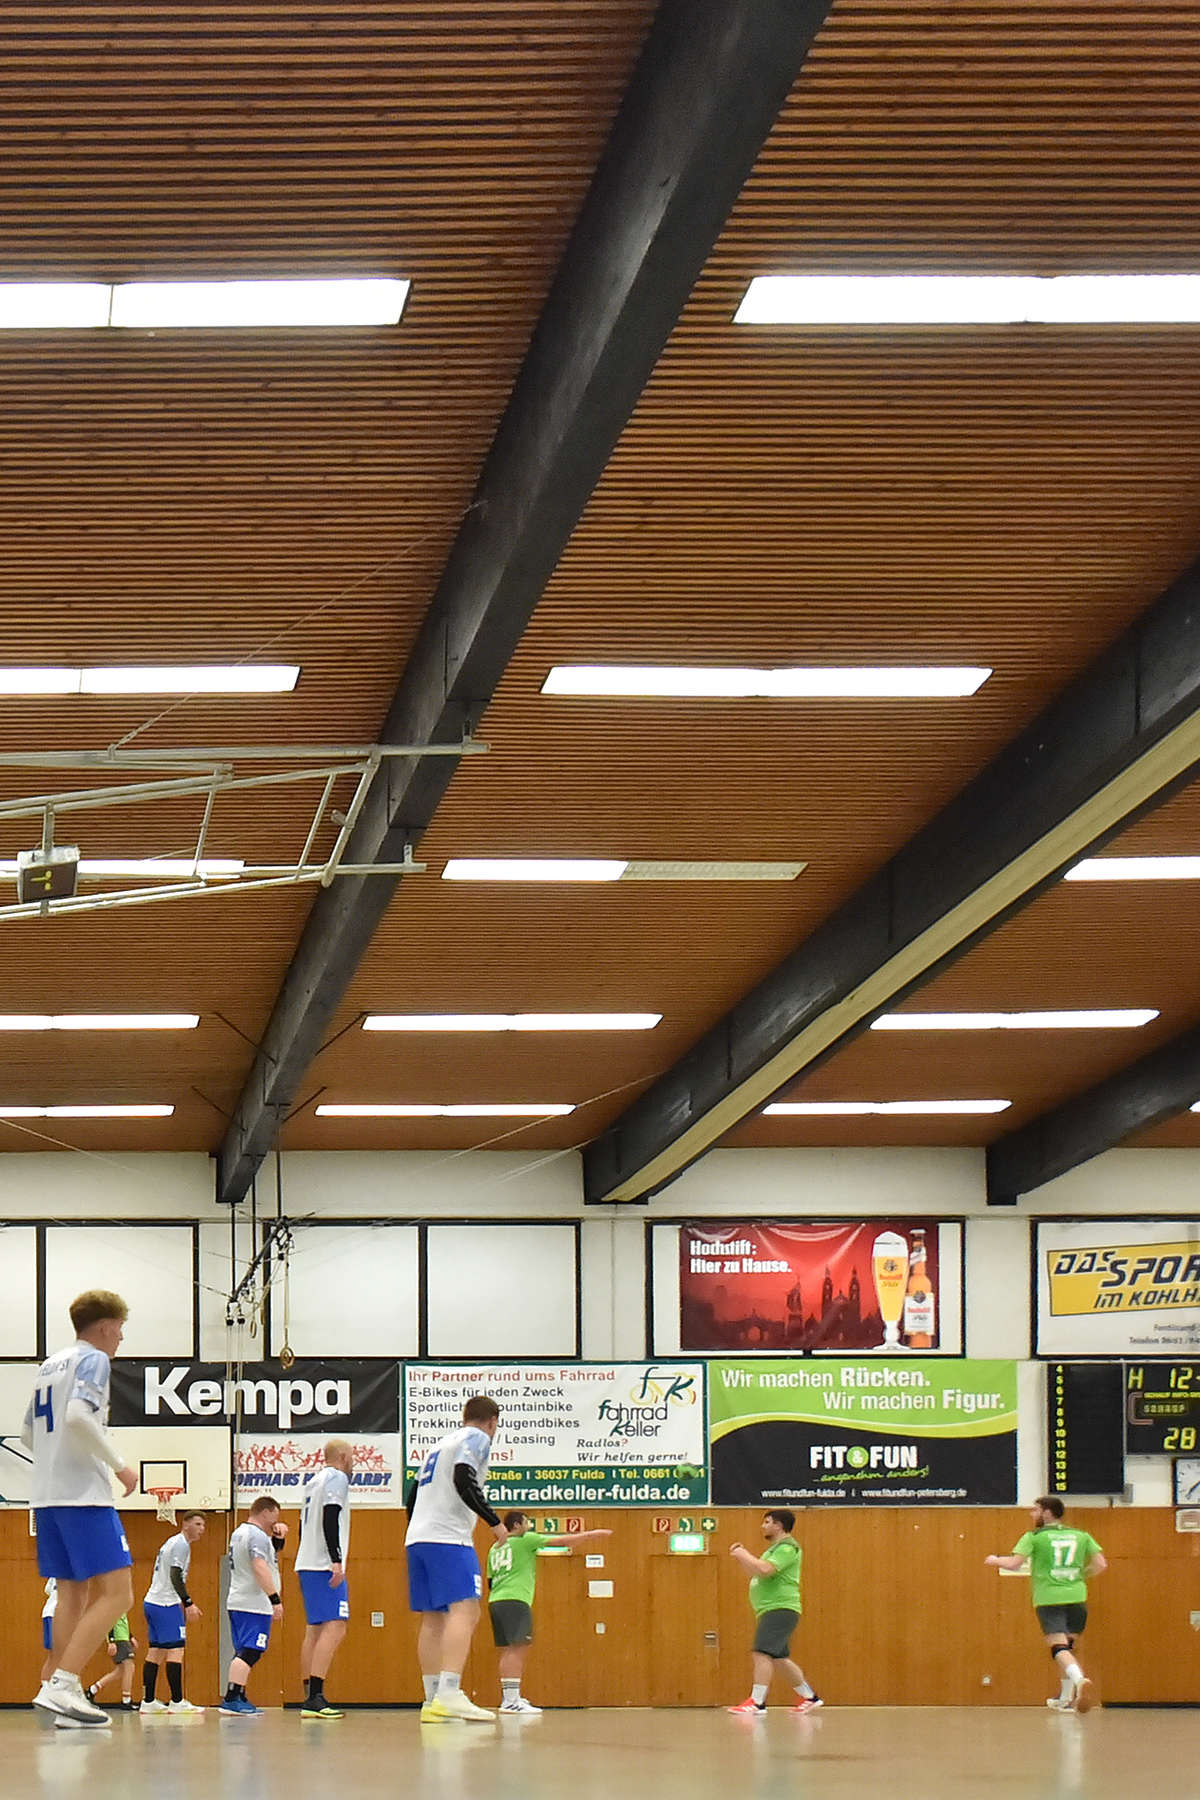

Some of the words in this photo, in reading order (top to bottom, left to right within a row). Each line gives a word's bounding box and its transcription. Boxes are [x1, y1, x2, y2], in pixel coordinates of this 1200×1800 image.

[690, 1258, 721, 1273] Hier
[724, 1261, 740, 1273] zu
[742, 1258, 792, 1273] Hause.
[1128, 1287, 1200, 1306] KOHLH
[1055, 1365, 1064, 1374] 4
[409, 1371, 428, 1381] Ihr
[432, 1371, 484, 1381] Partner
[488, 1370, 521, 1381] rund
[525, 1372, 556, 1381] ums
[560, 1370, 615, 1381] Fahrrad
[722, 1369, 751, 1387] Wir
[759, 1370, 833, 1387] machen
[840, 1367, 930, 1387] Rücken.
[1055, 1375, 1064, 1384] 5
[1128, 1367, 1144, 1389] H
[1169, 1367, 1200, 1389] 12
[409, 1387, 458, 1397] E-Bikes
[462, 1387, 480, 1397] für
[484, 1387, 519, 1397] jeden
[523, 1387, 564, 1397] Zweck
[1055, 1386, 1064, 1395] 6
[144, 1366, 350, 1429] Kempa
[823, 1391, 855, 1409] Wir
[861, 1391, 936, 1409] machen
[942, 1389, 1005, 1413] Figur.
[1055, 1397, 1064, 1406] 7
[35, 1384, 54, 1433] 4
[497, 1401, 573, 1412] ountainbike
[1055, 1407, 1064, 1416] 8
[497, 1417, 580, 1430] Jugendbikes
[1055, 1418, 1064, 1427] 9
[1055, 1428, 1067, 1438] 10
[1164, 1427, 1197, 1450] 28
[505, 1433, 555, 1446] Leasing
[576, 1438, 628, 1448] Radlos?
[1055, 1439, 1067, 1448] 11
[577, 1452, 600, 1461] Wir
[604, 1451, 643, 1461] helfen
[648, 1452, 688, 1463] gerne!
[1055, 1450, 1067, 1459] 12
[420, 1449, 441, 1487] 9
[1055, 1461, 1067, 1470] 13
[234, 1473, 300, 1486] ORTHAUS
[535, 1470, 569, 1480] 36037
[572, 1470, 605, 1479] Fulda
[643, 1469, 670, 1478] 0661
[1055, 1482, 1067, 1491] 15
[1051, 1540, 1077, 1566] 17
